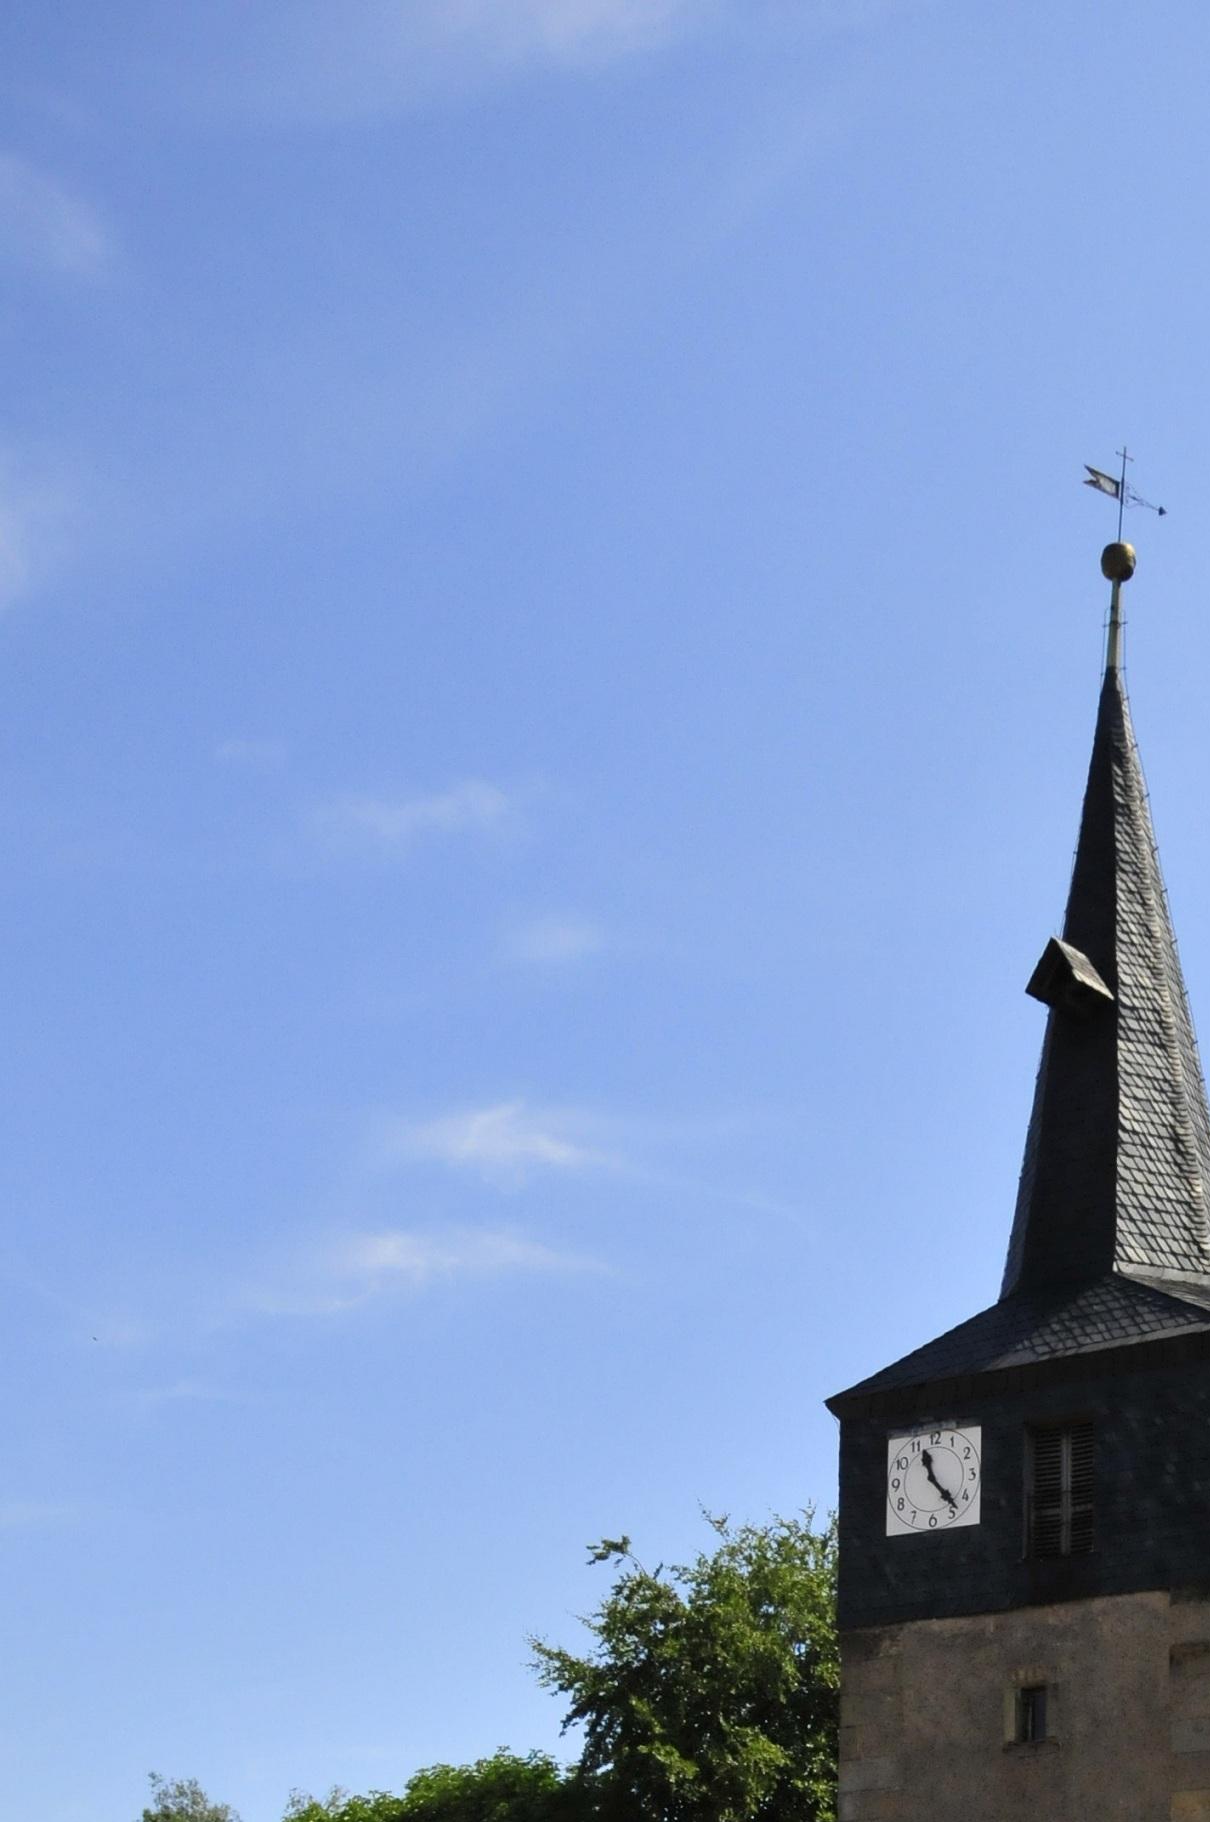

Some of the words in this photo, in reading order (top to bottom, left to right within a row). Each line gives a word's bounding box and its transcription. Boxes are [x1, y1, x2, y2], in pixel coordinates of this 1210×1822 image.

[930, 1431, 941, 1445] 12
[911, 1441, 920, 1453] 11
[963, 1446, 971, 1460] 2
[896, 1457, 909, 1471] 10
[968, 1468, 976, 1481] 3
[891, 1478, 900, 1492] 9
[962, 1488, 969, 1501] 4
[897, 1497, 905, 1511] 8
[910, 1510, 917, 1524] 7
[948, 1505, 956, 1519] 5
[928, 1513, 937, 1528] 6
